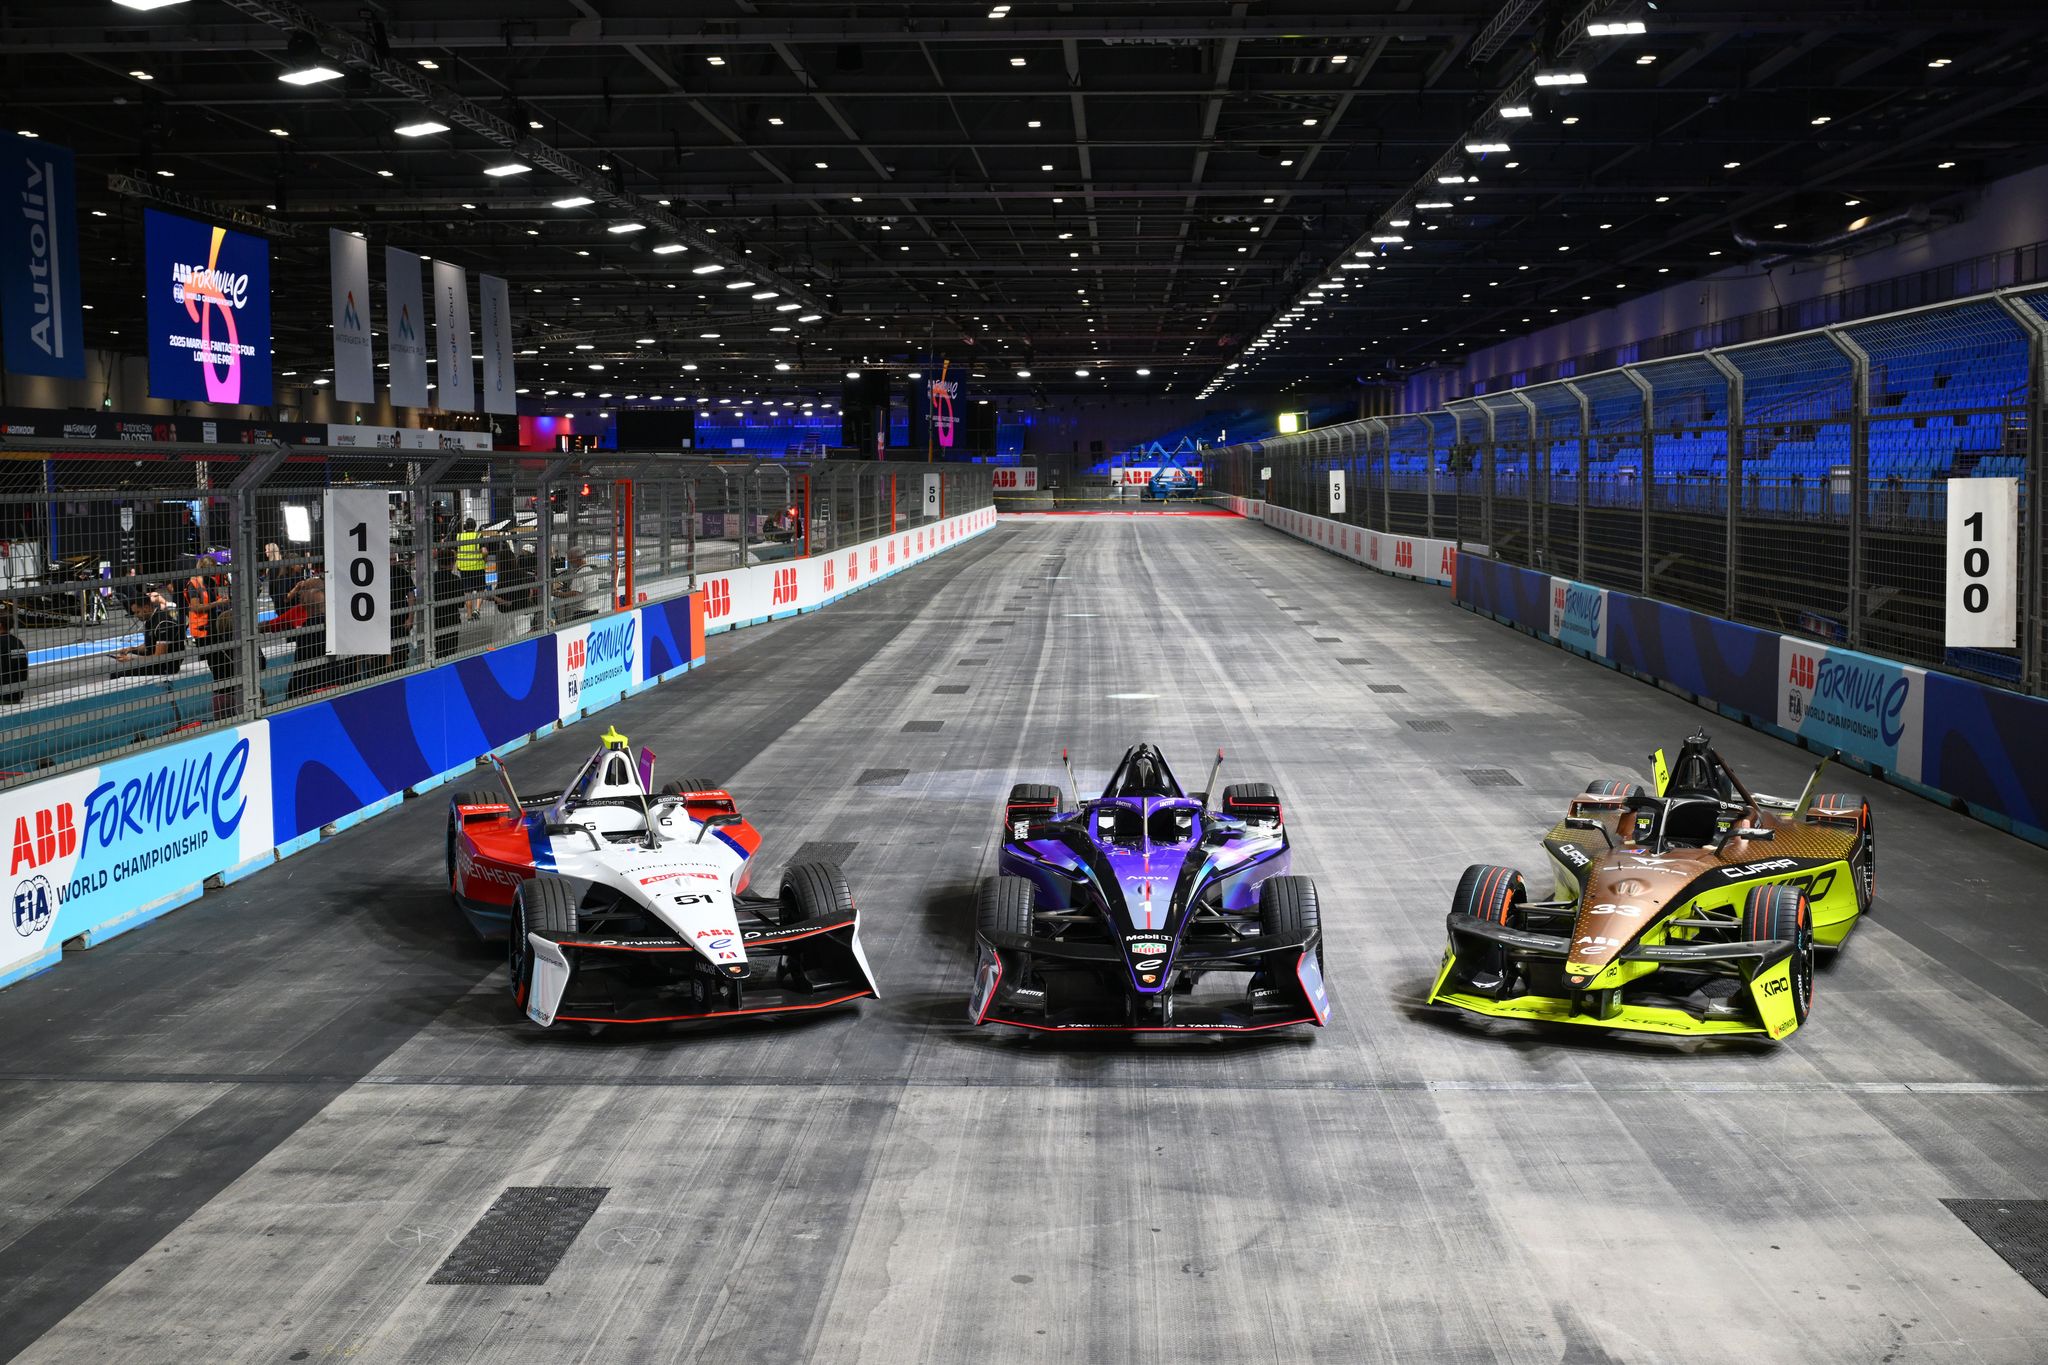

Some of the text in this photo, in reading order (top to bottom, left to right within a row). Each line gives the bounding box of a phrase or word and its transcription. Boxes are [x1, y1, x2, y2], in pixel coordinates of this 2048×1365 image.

[22, 157, 52, 355] Autoliv
[173, 262, 192, 284] ABB
[192, 265, 235, 295] FORMULA
[169, 335, 255, 356] 2025 MARVEL FANTASTIC FOUR
[193, 350, 217, 364] LONDON
[992, 471, 1016, 487] ABB
[1024, 471, 1035, 487] ABB
[1334, 483, 1340, 500] 50
[929, 486, 935, 503] 50
[1395, 540, 1412, 568] ABB
[1441, 546, 1456, 575] AB
[1963, 512, 1990, 613] 100
[349, 522, 375, 621] 100
[823, 559, 834, 593] ABB
[848, 552, 857, 583] ABB
[703, 578, 730, 619] ABB
[773, 568, 797, 606] ABB
[1554, 587, 1564, 609] ABB
[1566, 588, 1592, 621] FORMULA
[567, 639, 585, 672] ABB
[586, 623, 625, 669] FORMULA
[580, 675, 594, 691] WORLD
[594, 665, 623, 686] CHAMPIONSHIP
[1789, 653, 1815, 690] ABB
[1815, 658, 1885, 718] FORMULA
[1804, 703, 1826, 722] WORLD
[1827, 712, 1879, 740] CHAMPIONSHIP
[10, 802, 77, 876] ABB
[80, 752, 213, 860] FORMULA
[660, 817, 673, 826] G
[57, 870, 108, 905] WORLD
[113, 830, 208, 879] CHAMPIONSHIP
[1559, 843, 1590, 867] CUPRA
[1722, 858, 1798, 878] CUPRA
[674, 894, 713, 905] 51
[1138, 901, 1152, 912] 1
[1590, 904, 1641, 917] 33
[697, 929, 734, 939] ABB
[765, 926, 822, 937] prysmian
[1576, 936, 1620, 946] ABB
[1016, 989, 1044, 997] LOCTITE
[1761, 977, 1789, 997] KIRO
